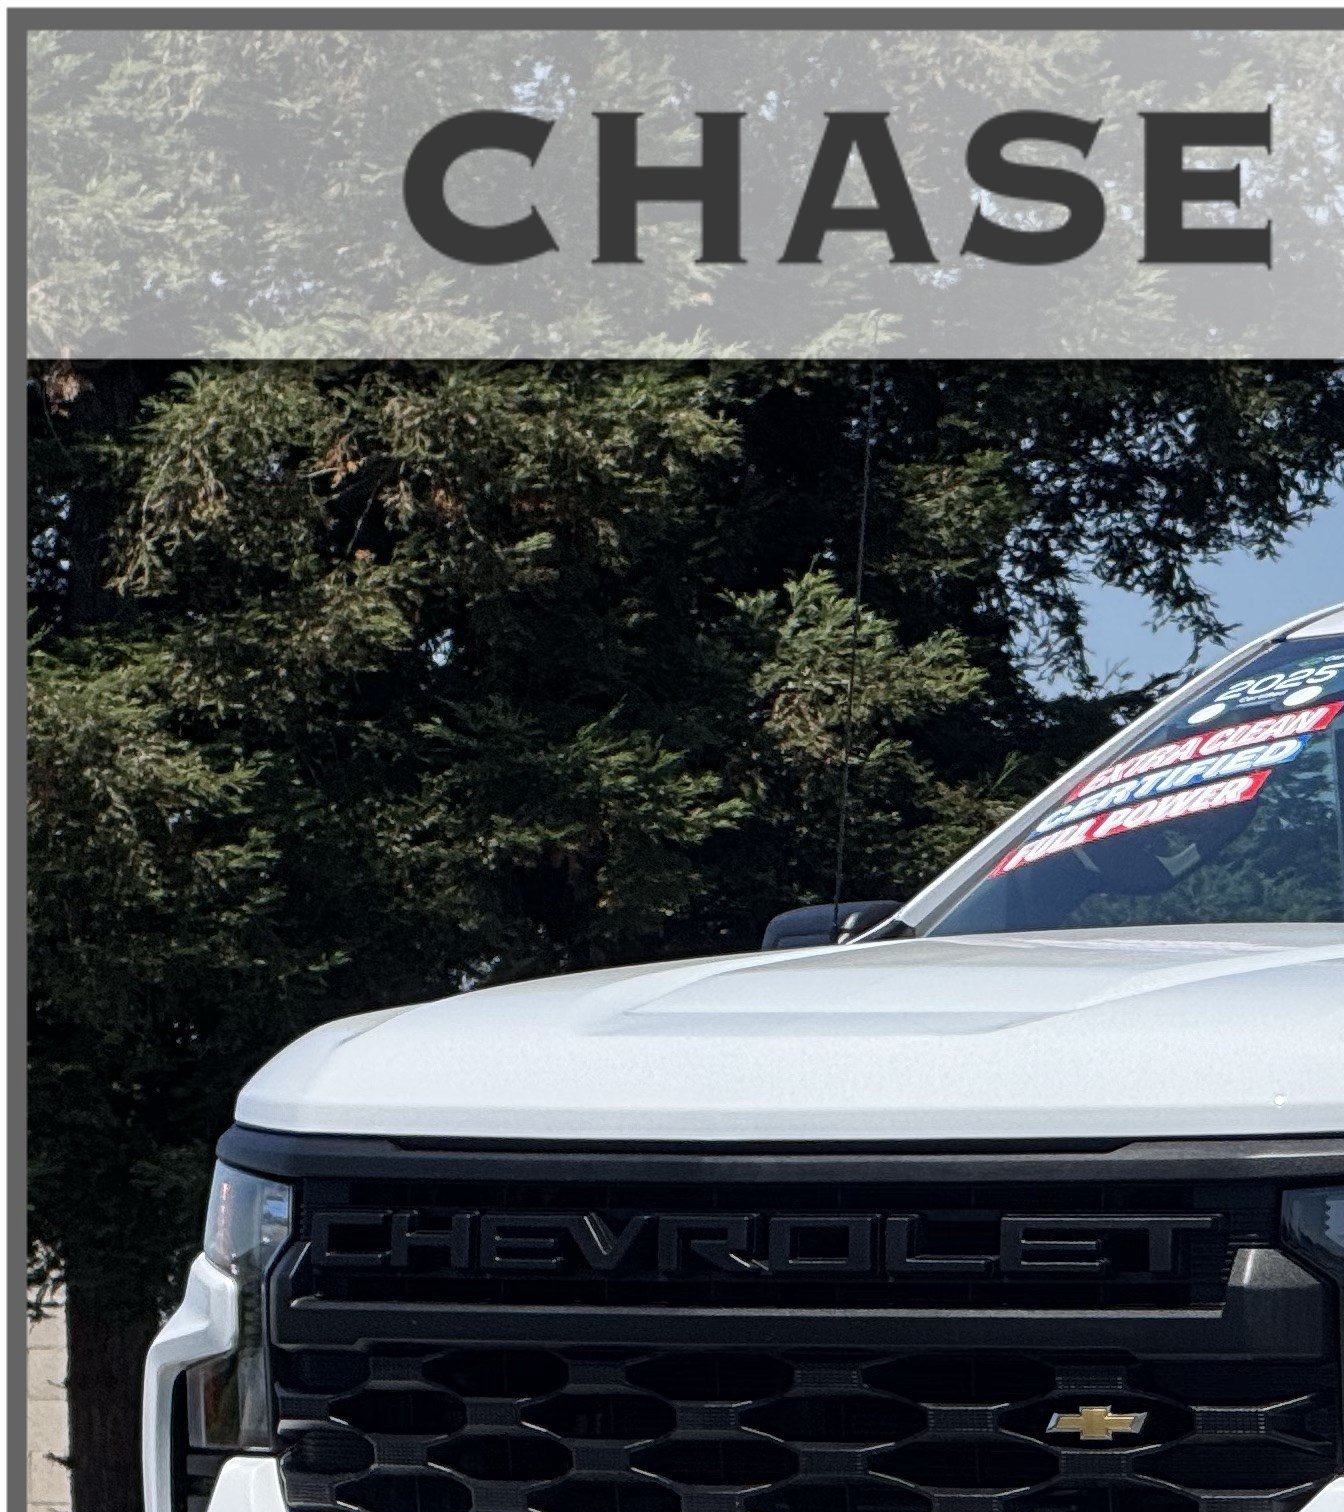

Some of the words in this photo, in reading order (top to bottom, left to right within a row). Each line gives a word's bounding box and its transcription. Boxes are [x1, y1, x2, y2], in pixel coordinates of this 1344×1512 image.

[1036, 738, 1302, 833] CERTIFIED
[1078, 736, 1203, 797] EXTRA
[1199, 706, 1331, 755] CLEAN
[1003, 817, 1097, 872] FULL
[1093, 776, 1253, 838] POWER
[311, 1210, 1225, 1275] CHEVROLET
